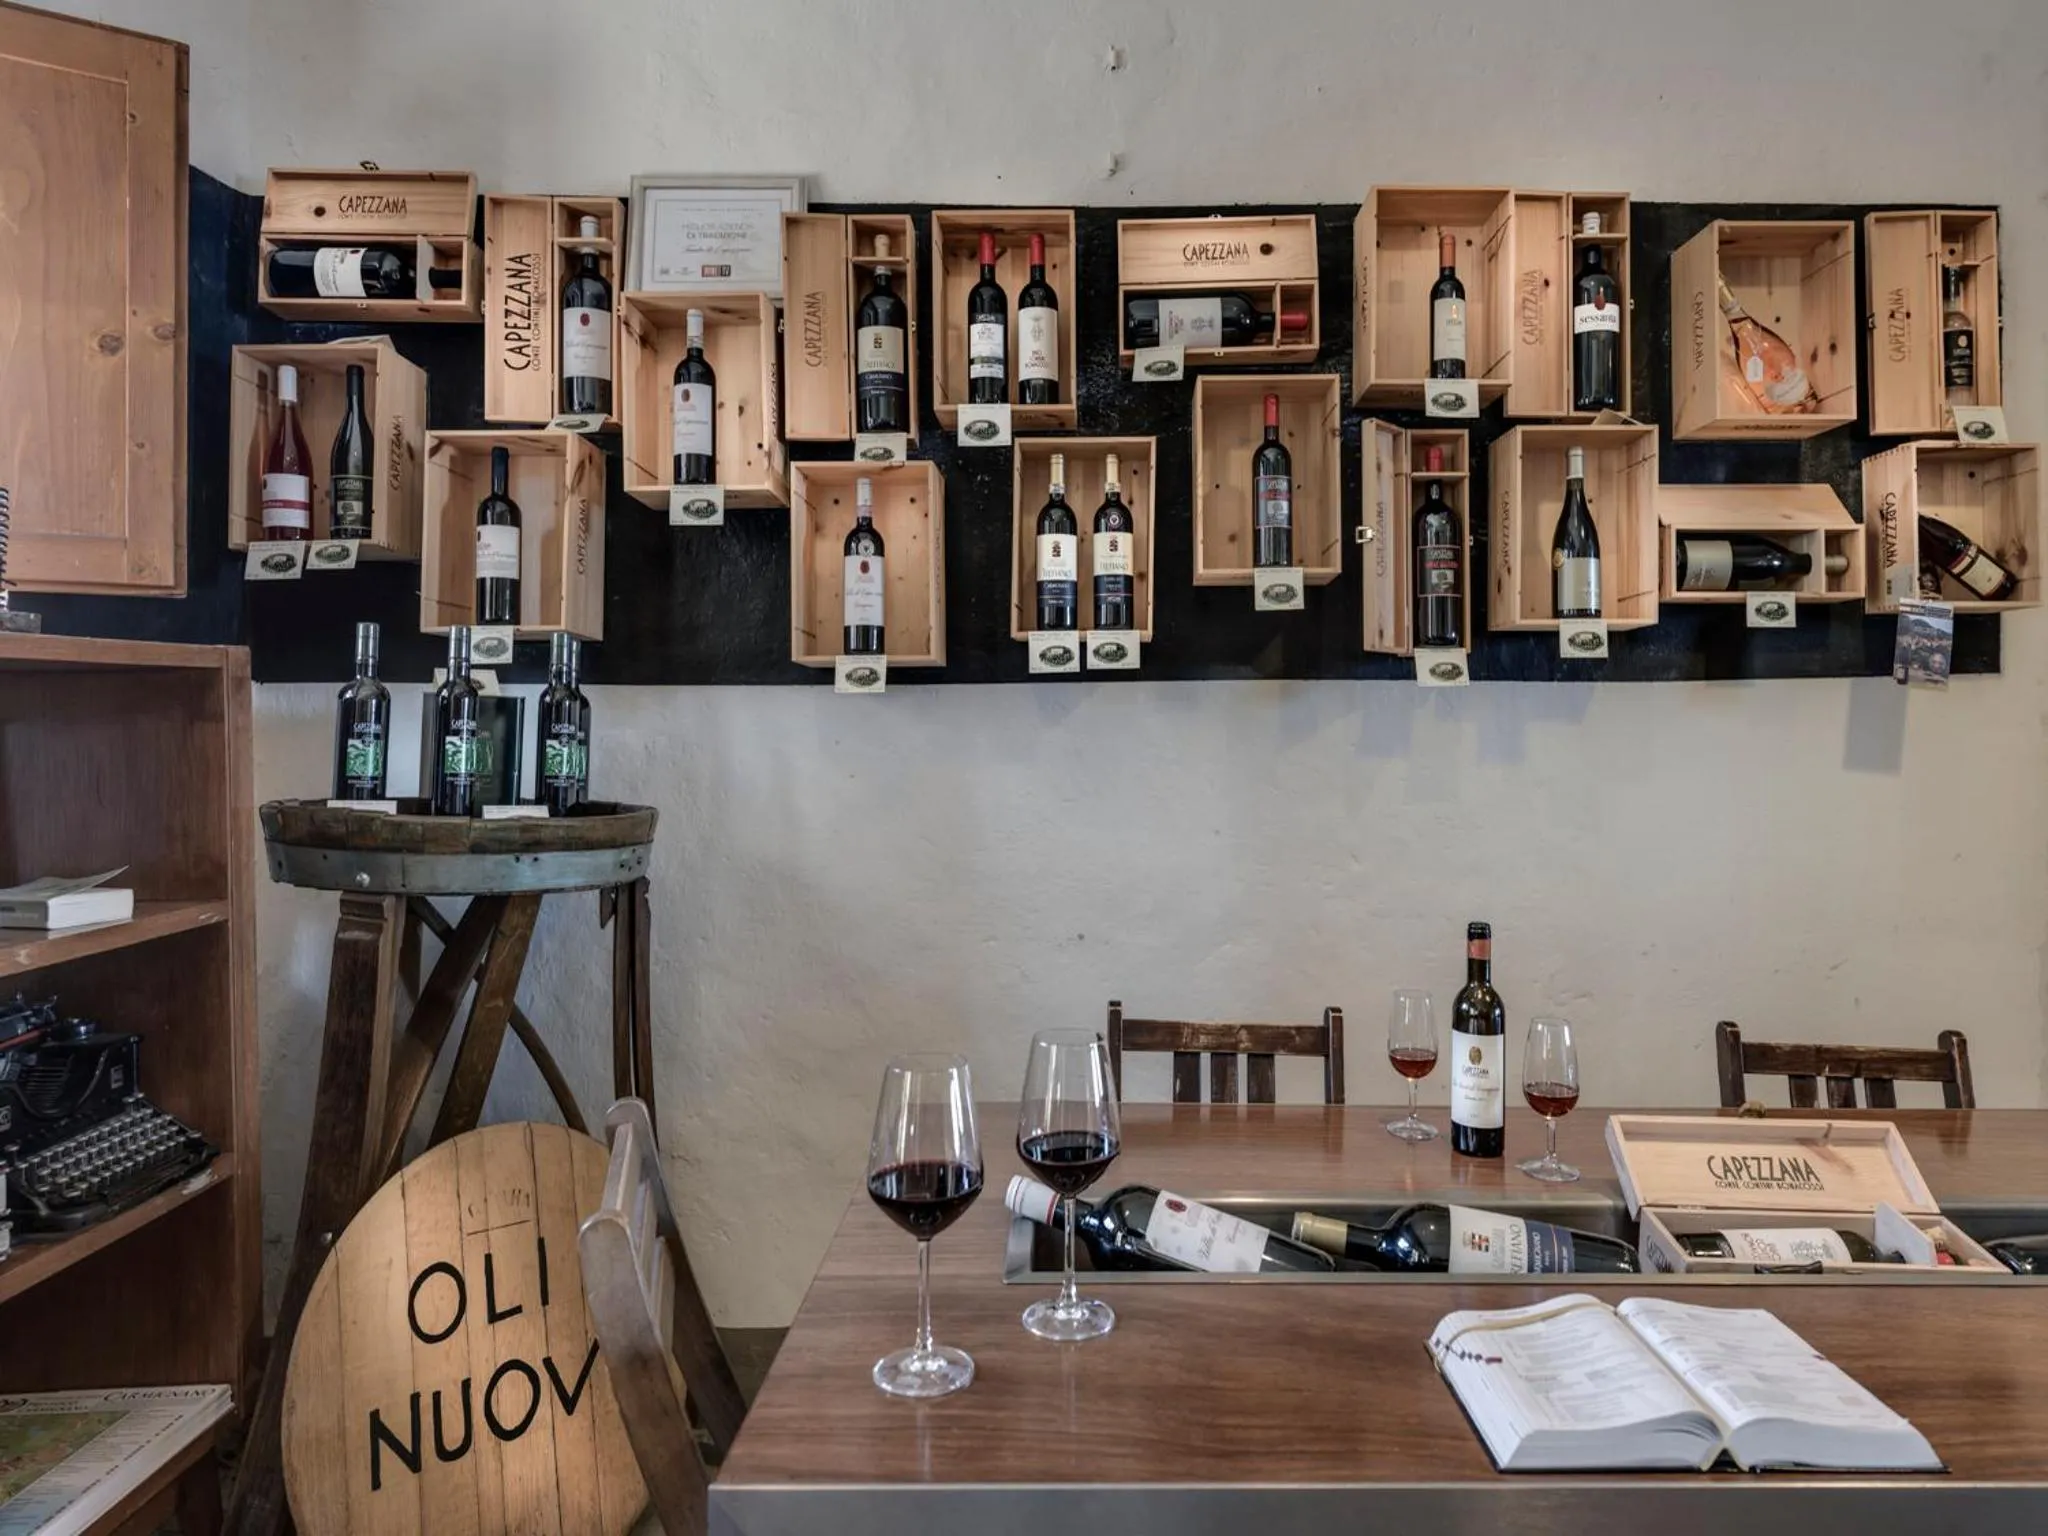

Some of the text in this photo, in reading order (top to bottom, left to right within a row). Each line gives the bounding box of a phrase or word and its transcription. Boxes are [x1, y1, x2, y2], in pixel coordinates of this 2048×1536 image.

[339, 195, 407, 214] CAPEZZANA
[1182, 243, 1250, 261] CAPEZZANA
[504, 253, 532, 371] CAPEZZANA
[805, 291, 822, 367] CAPEZZANA
[1522, 269, 1538, 345] CAPEZZANA
[1889, 288, 1905, 362] CAPEZZANA
[389, 415, 402, 491] CAPEZZANA
[577, 499, 587, 575] CAPEZZANA
[1884, 492, 1898, 568] CAPEZZANA
[1707, 1155, 1821, 1182] CAPEZZANA
[408, 1236, 549, 1344] OLI
